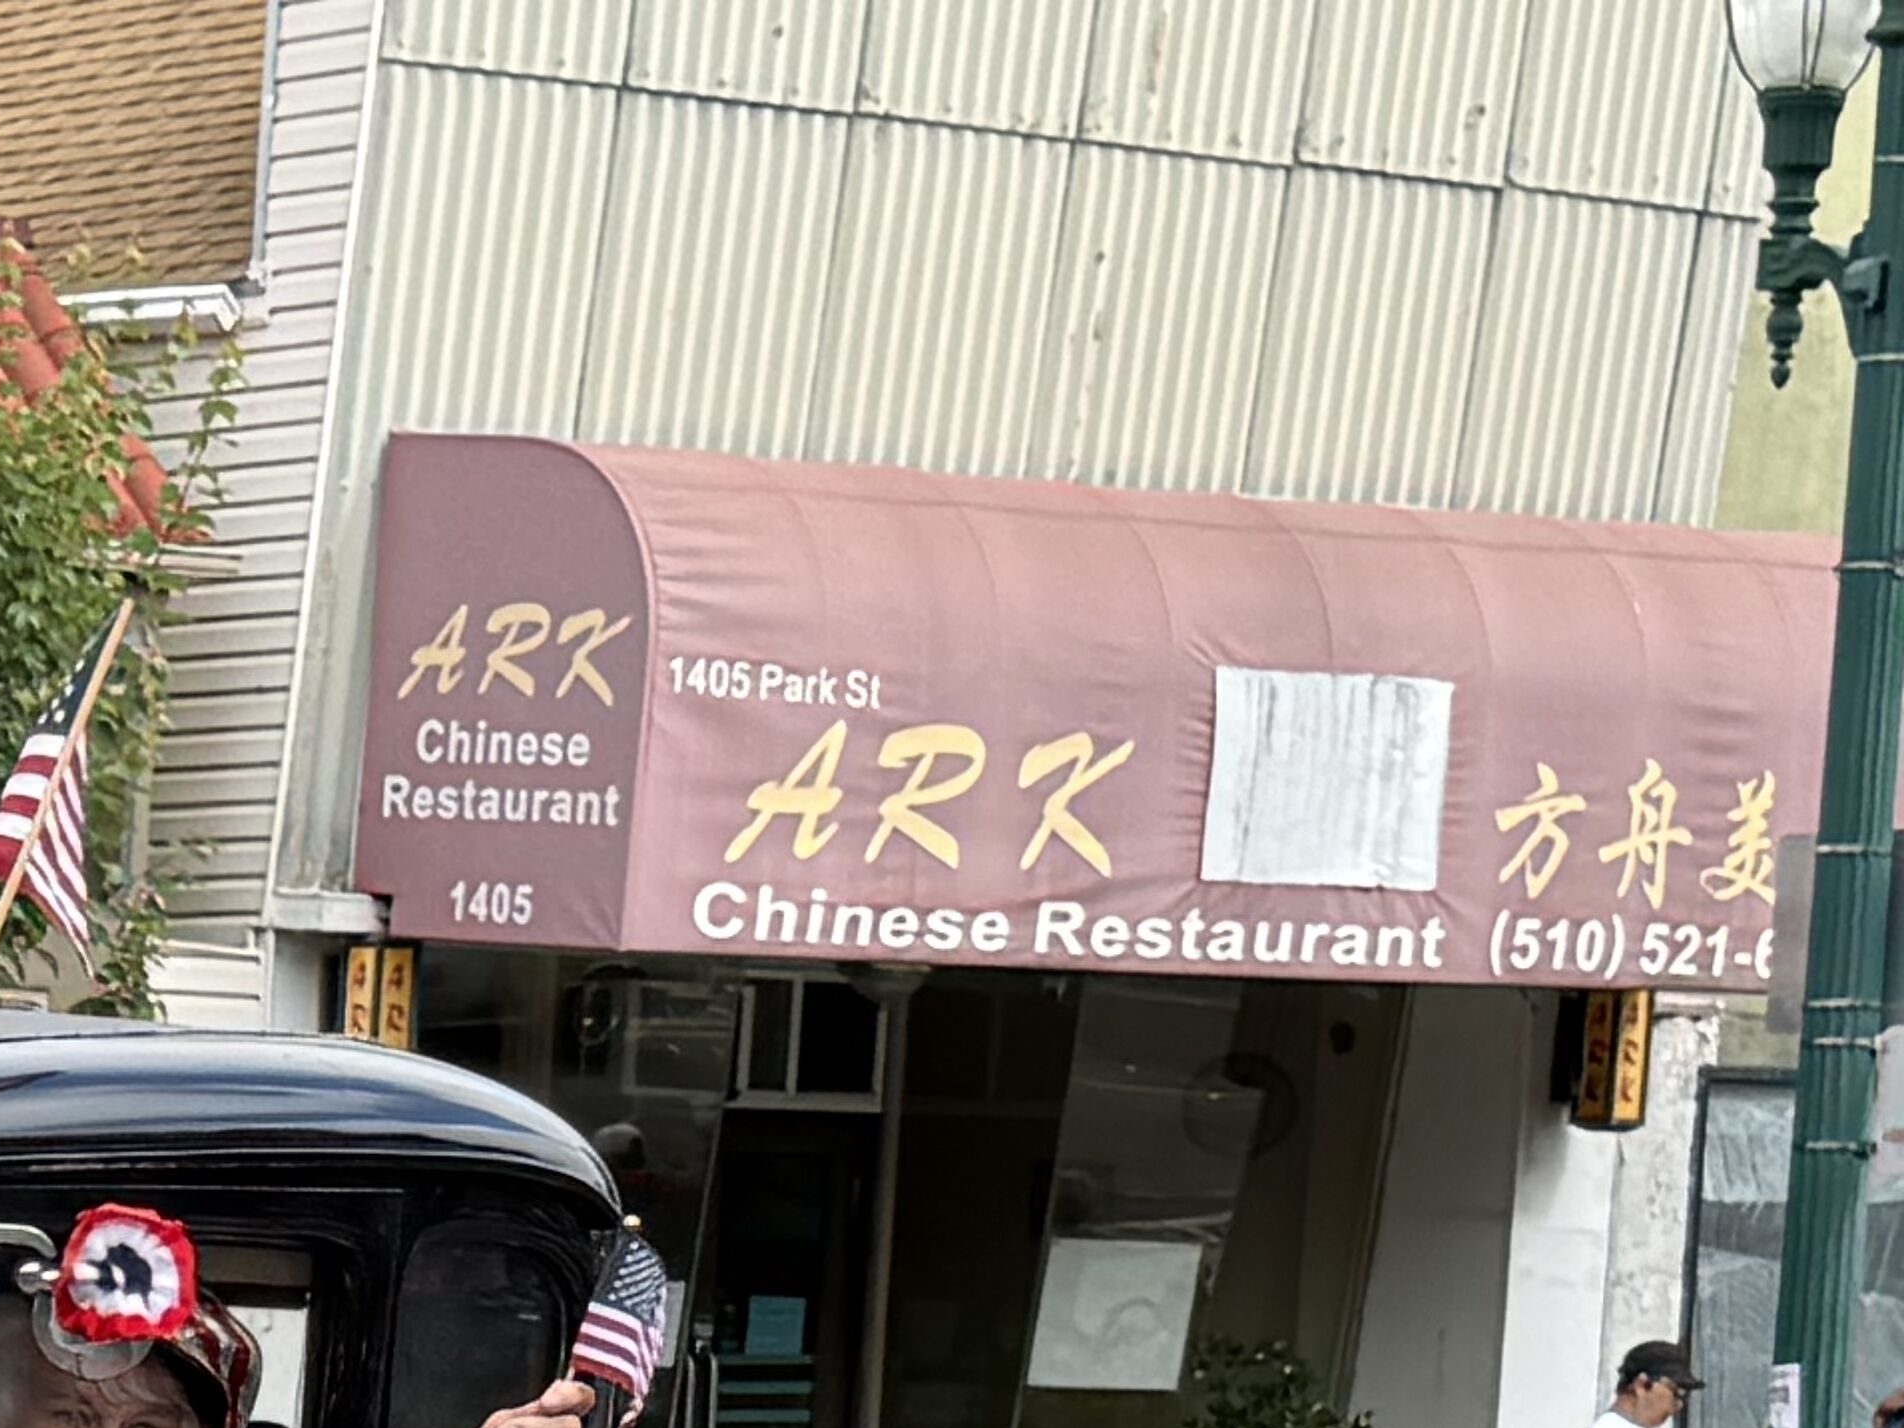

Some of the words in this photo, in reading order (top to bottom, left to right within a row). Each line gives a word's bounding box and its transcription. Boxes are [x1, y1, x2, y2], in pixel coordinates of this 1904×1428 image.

[397, 602, 633, 706] ARK
[670, 656, 751, 700] 1405
[759, 662, 837, 705] Park
[845, 671, 881, 709] St
[416, 718, 591, 766] Chinese
[382, 775, 620, 826] Restaurant
[724, 719, 1136, 877] ARK
[450, 881, 533, 925] 1405
[692, 881, 1011, 954] Chinese
[1033, 900, 1447, 969] Restaurant
[1490, 908, 1625, 981] (510)
